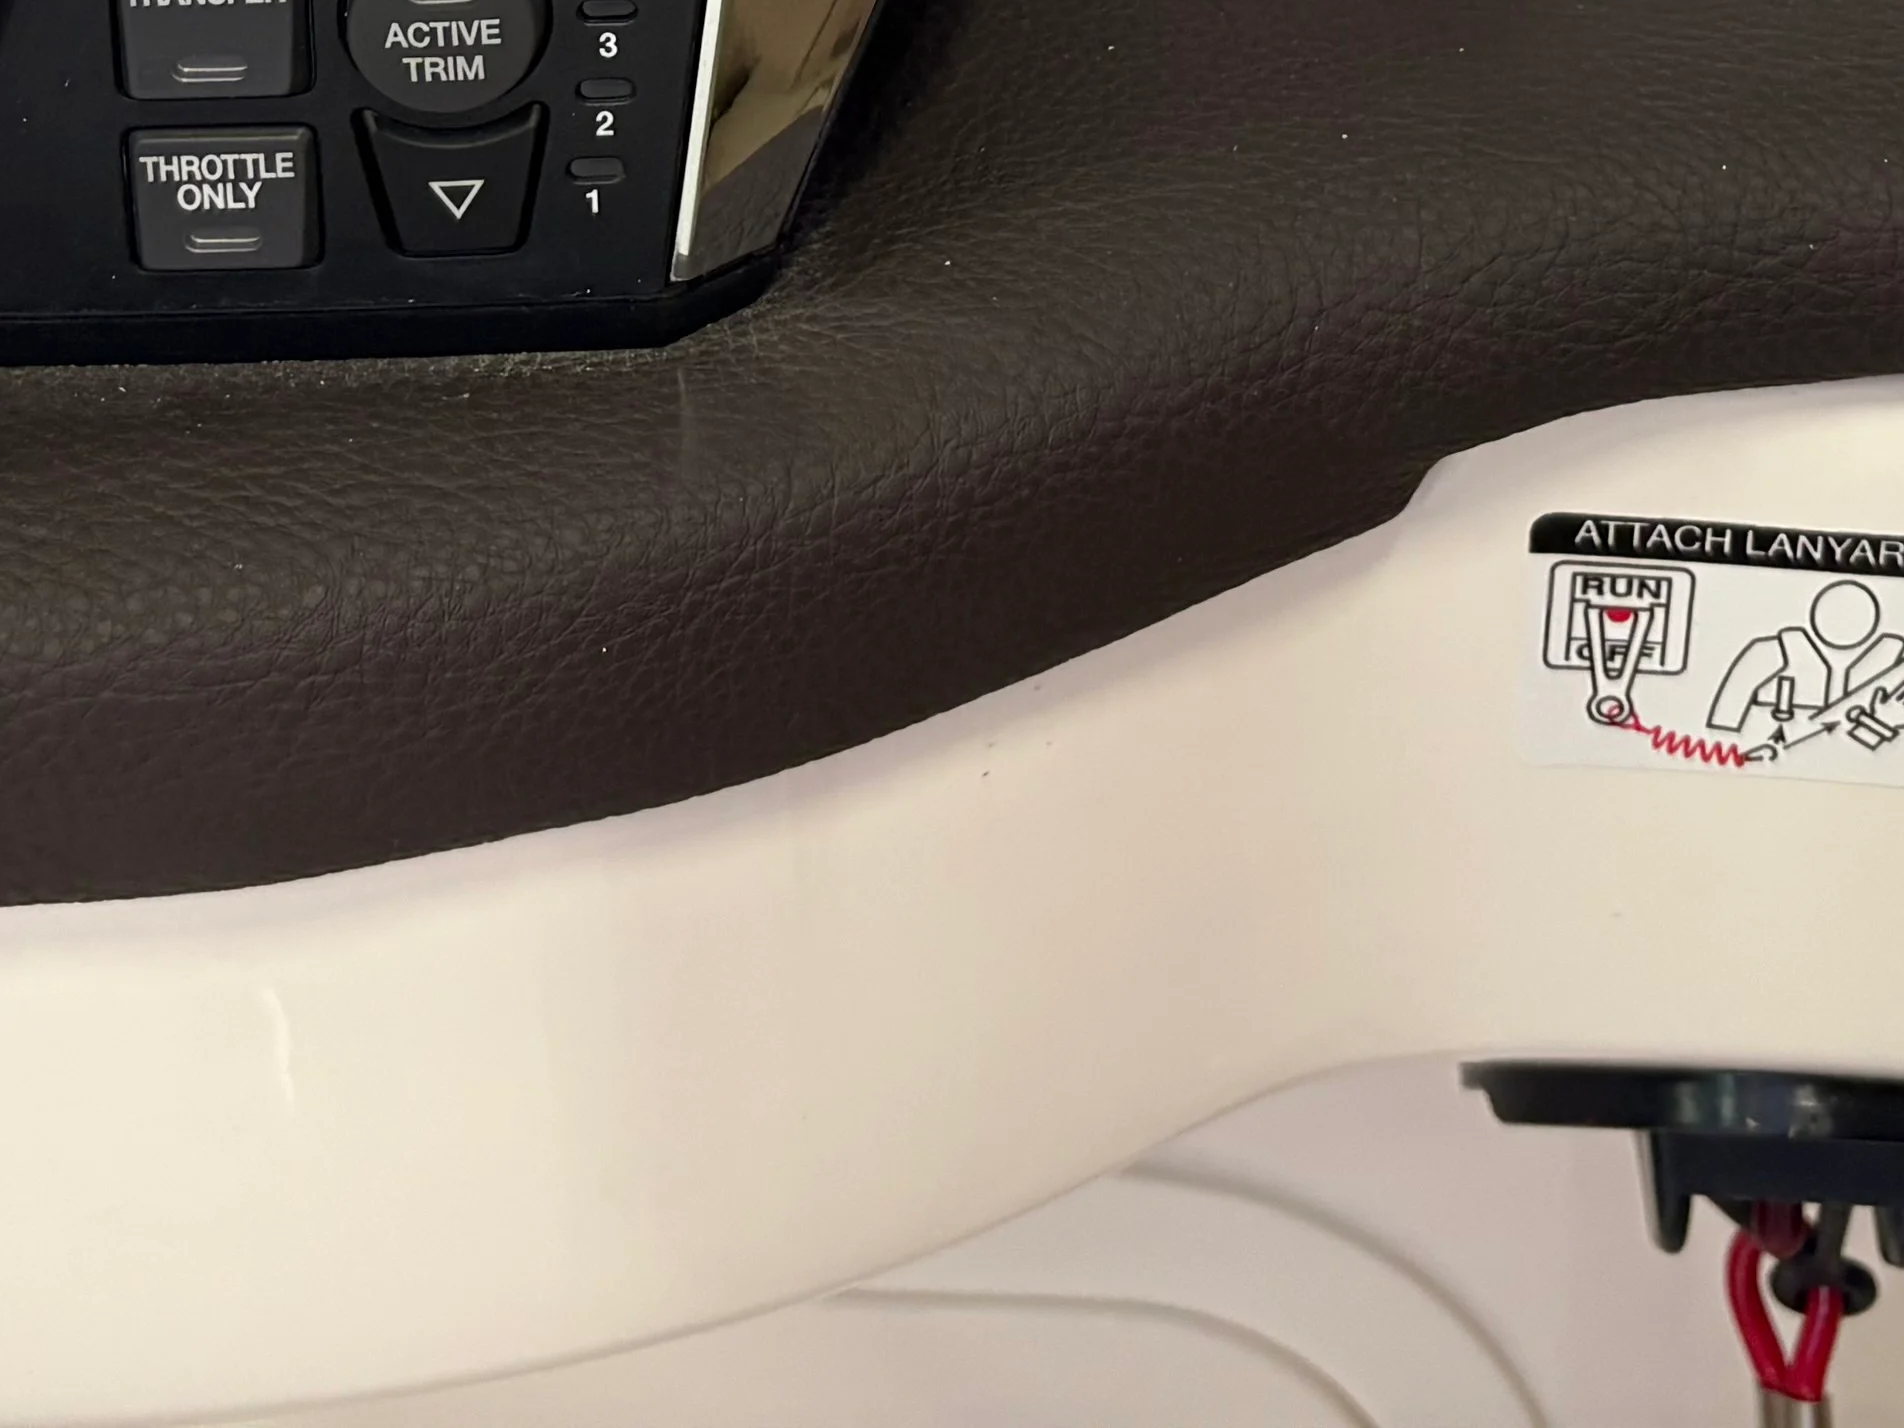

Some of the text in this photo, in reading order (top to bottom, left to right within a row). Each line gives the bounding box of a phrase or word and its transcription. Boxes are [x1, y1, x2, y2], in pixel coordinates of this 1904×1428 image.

[384, 20, 501, 49] ACTIVE
[600, 32, 617, 58] 3
[402, 55, 485, 82] TRIM
[596, 110, 614, 136] 2
[139, 152, 295, 181] THROTTLE
[177, 182, 263, 210] ONLY
[586, 190, 600, 213] 1
[1575, 520, 1731, 555] ATTACH
[1581, 575, 1662, 600] RUN
